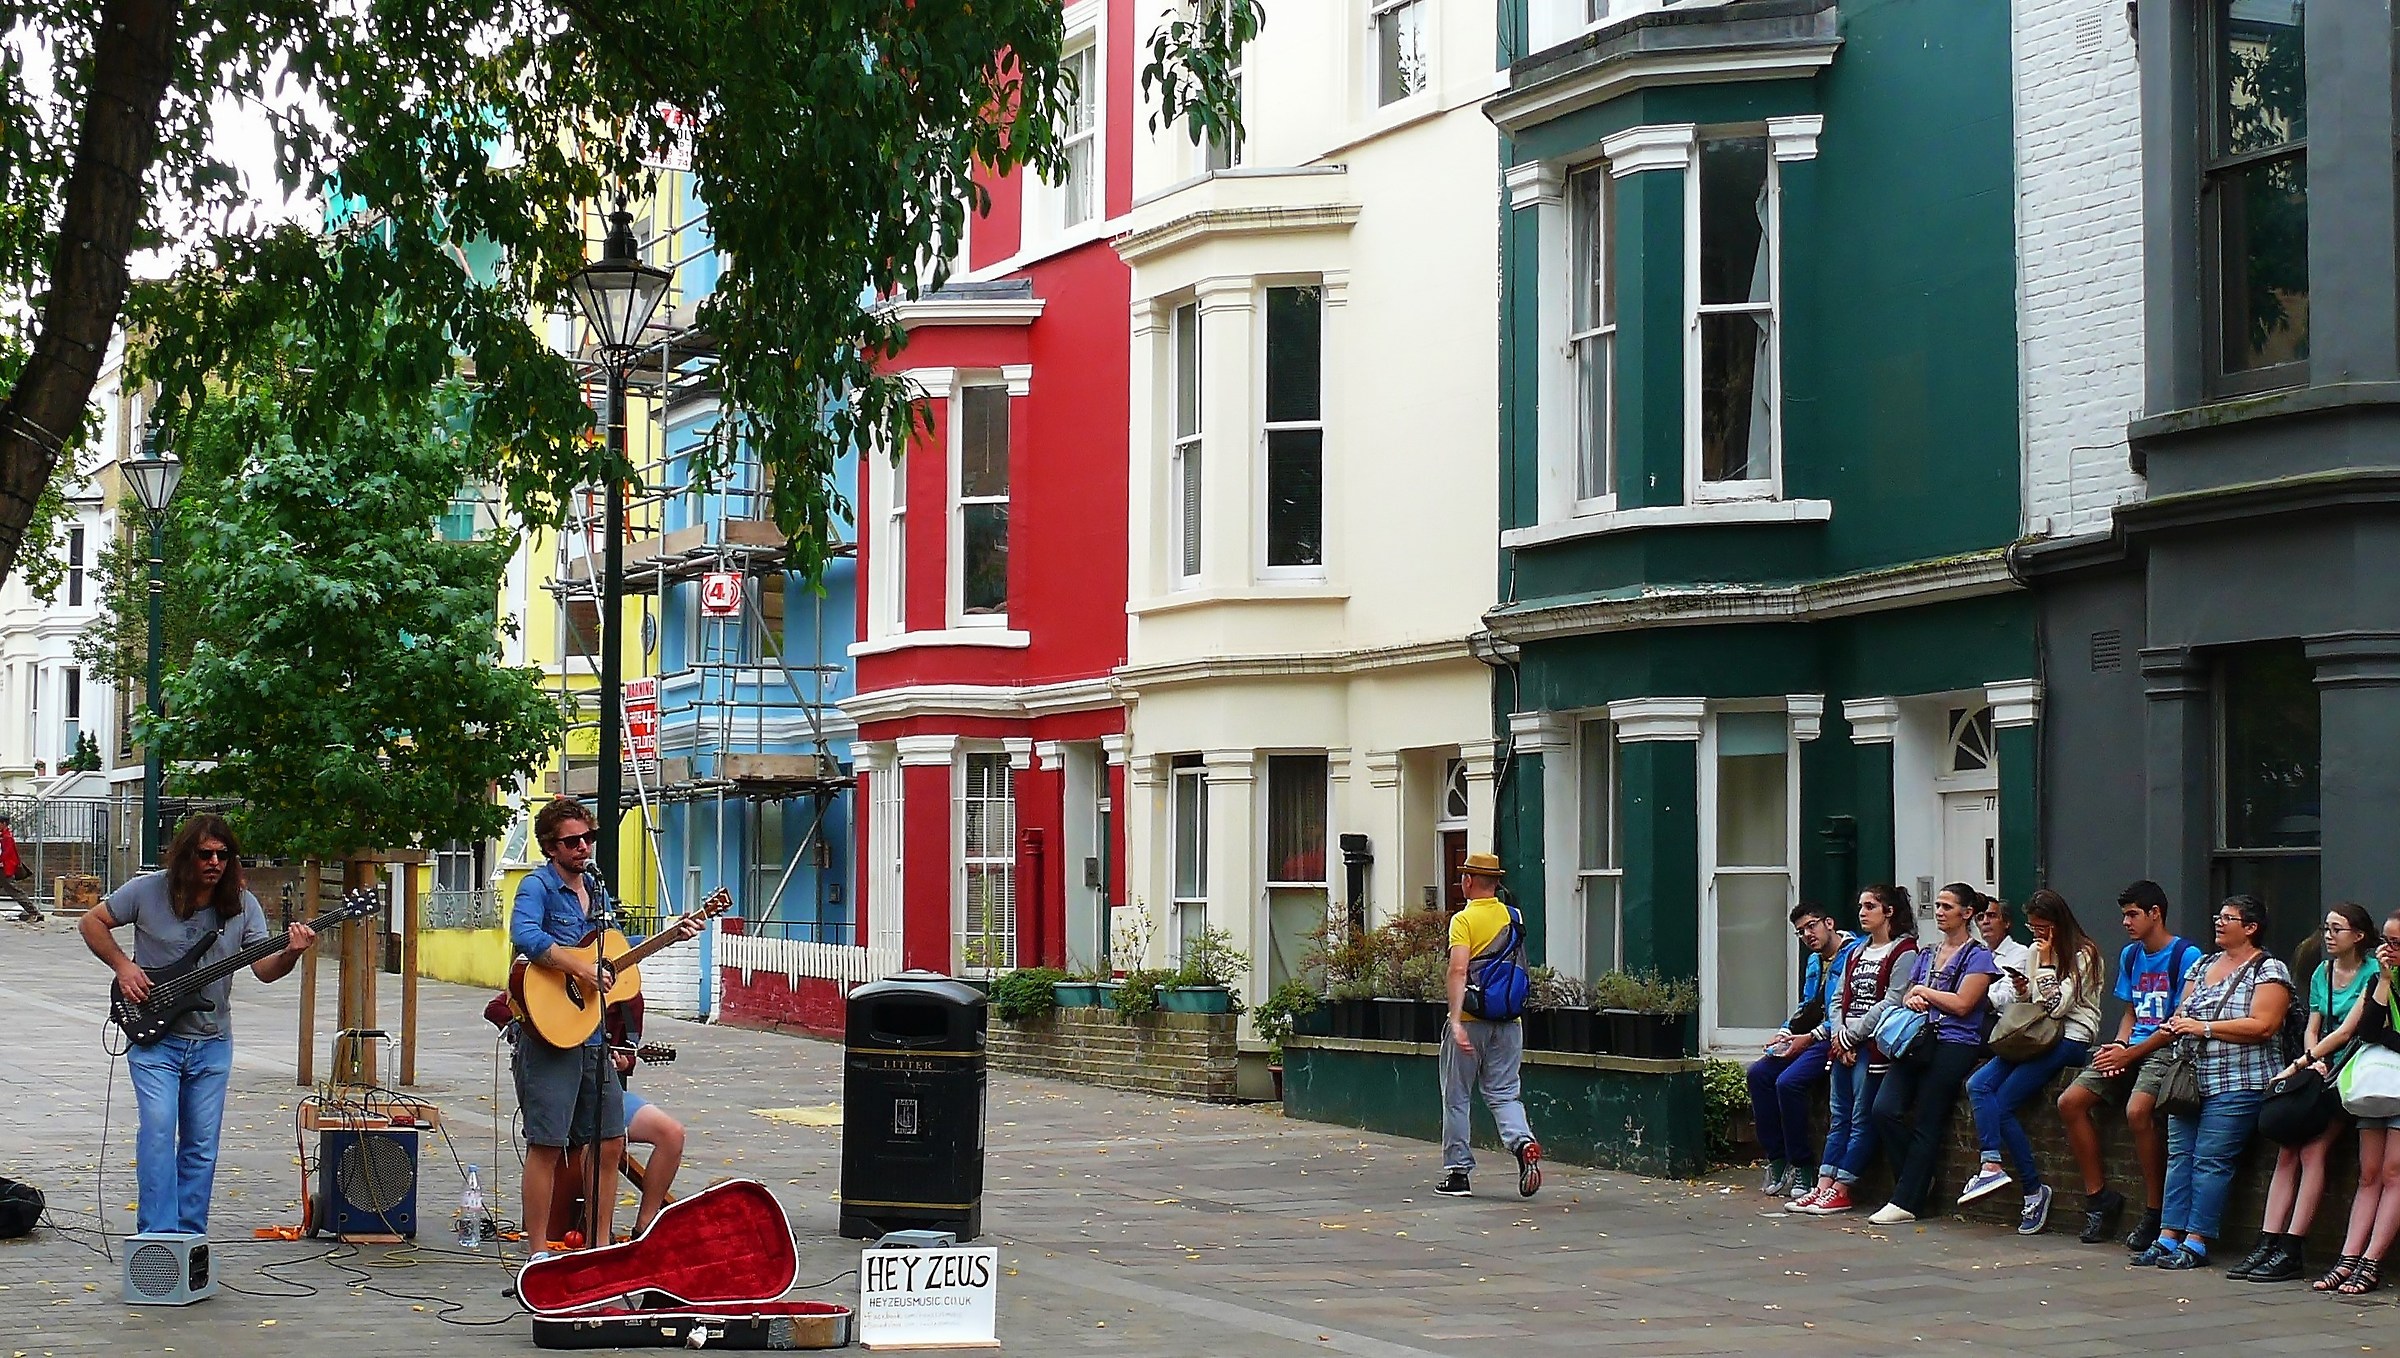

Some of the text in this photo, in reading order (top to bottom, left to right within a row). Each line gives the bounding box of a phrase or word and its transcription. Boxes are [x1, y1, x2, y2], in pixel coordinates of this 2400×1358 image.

[625, 681, 655, 699] WARNING
[1983, 796, 1996, 811] 77
[883, 1060, 933, 1070] LITTER
[866, 1255, 991, 1293] HEY ZEUS
